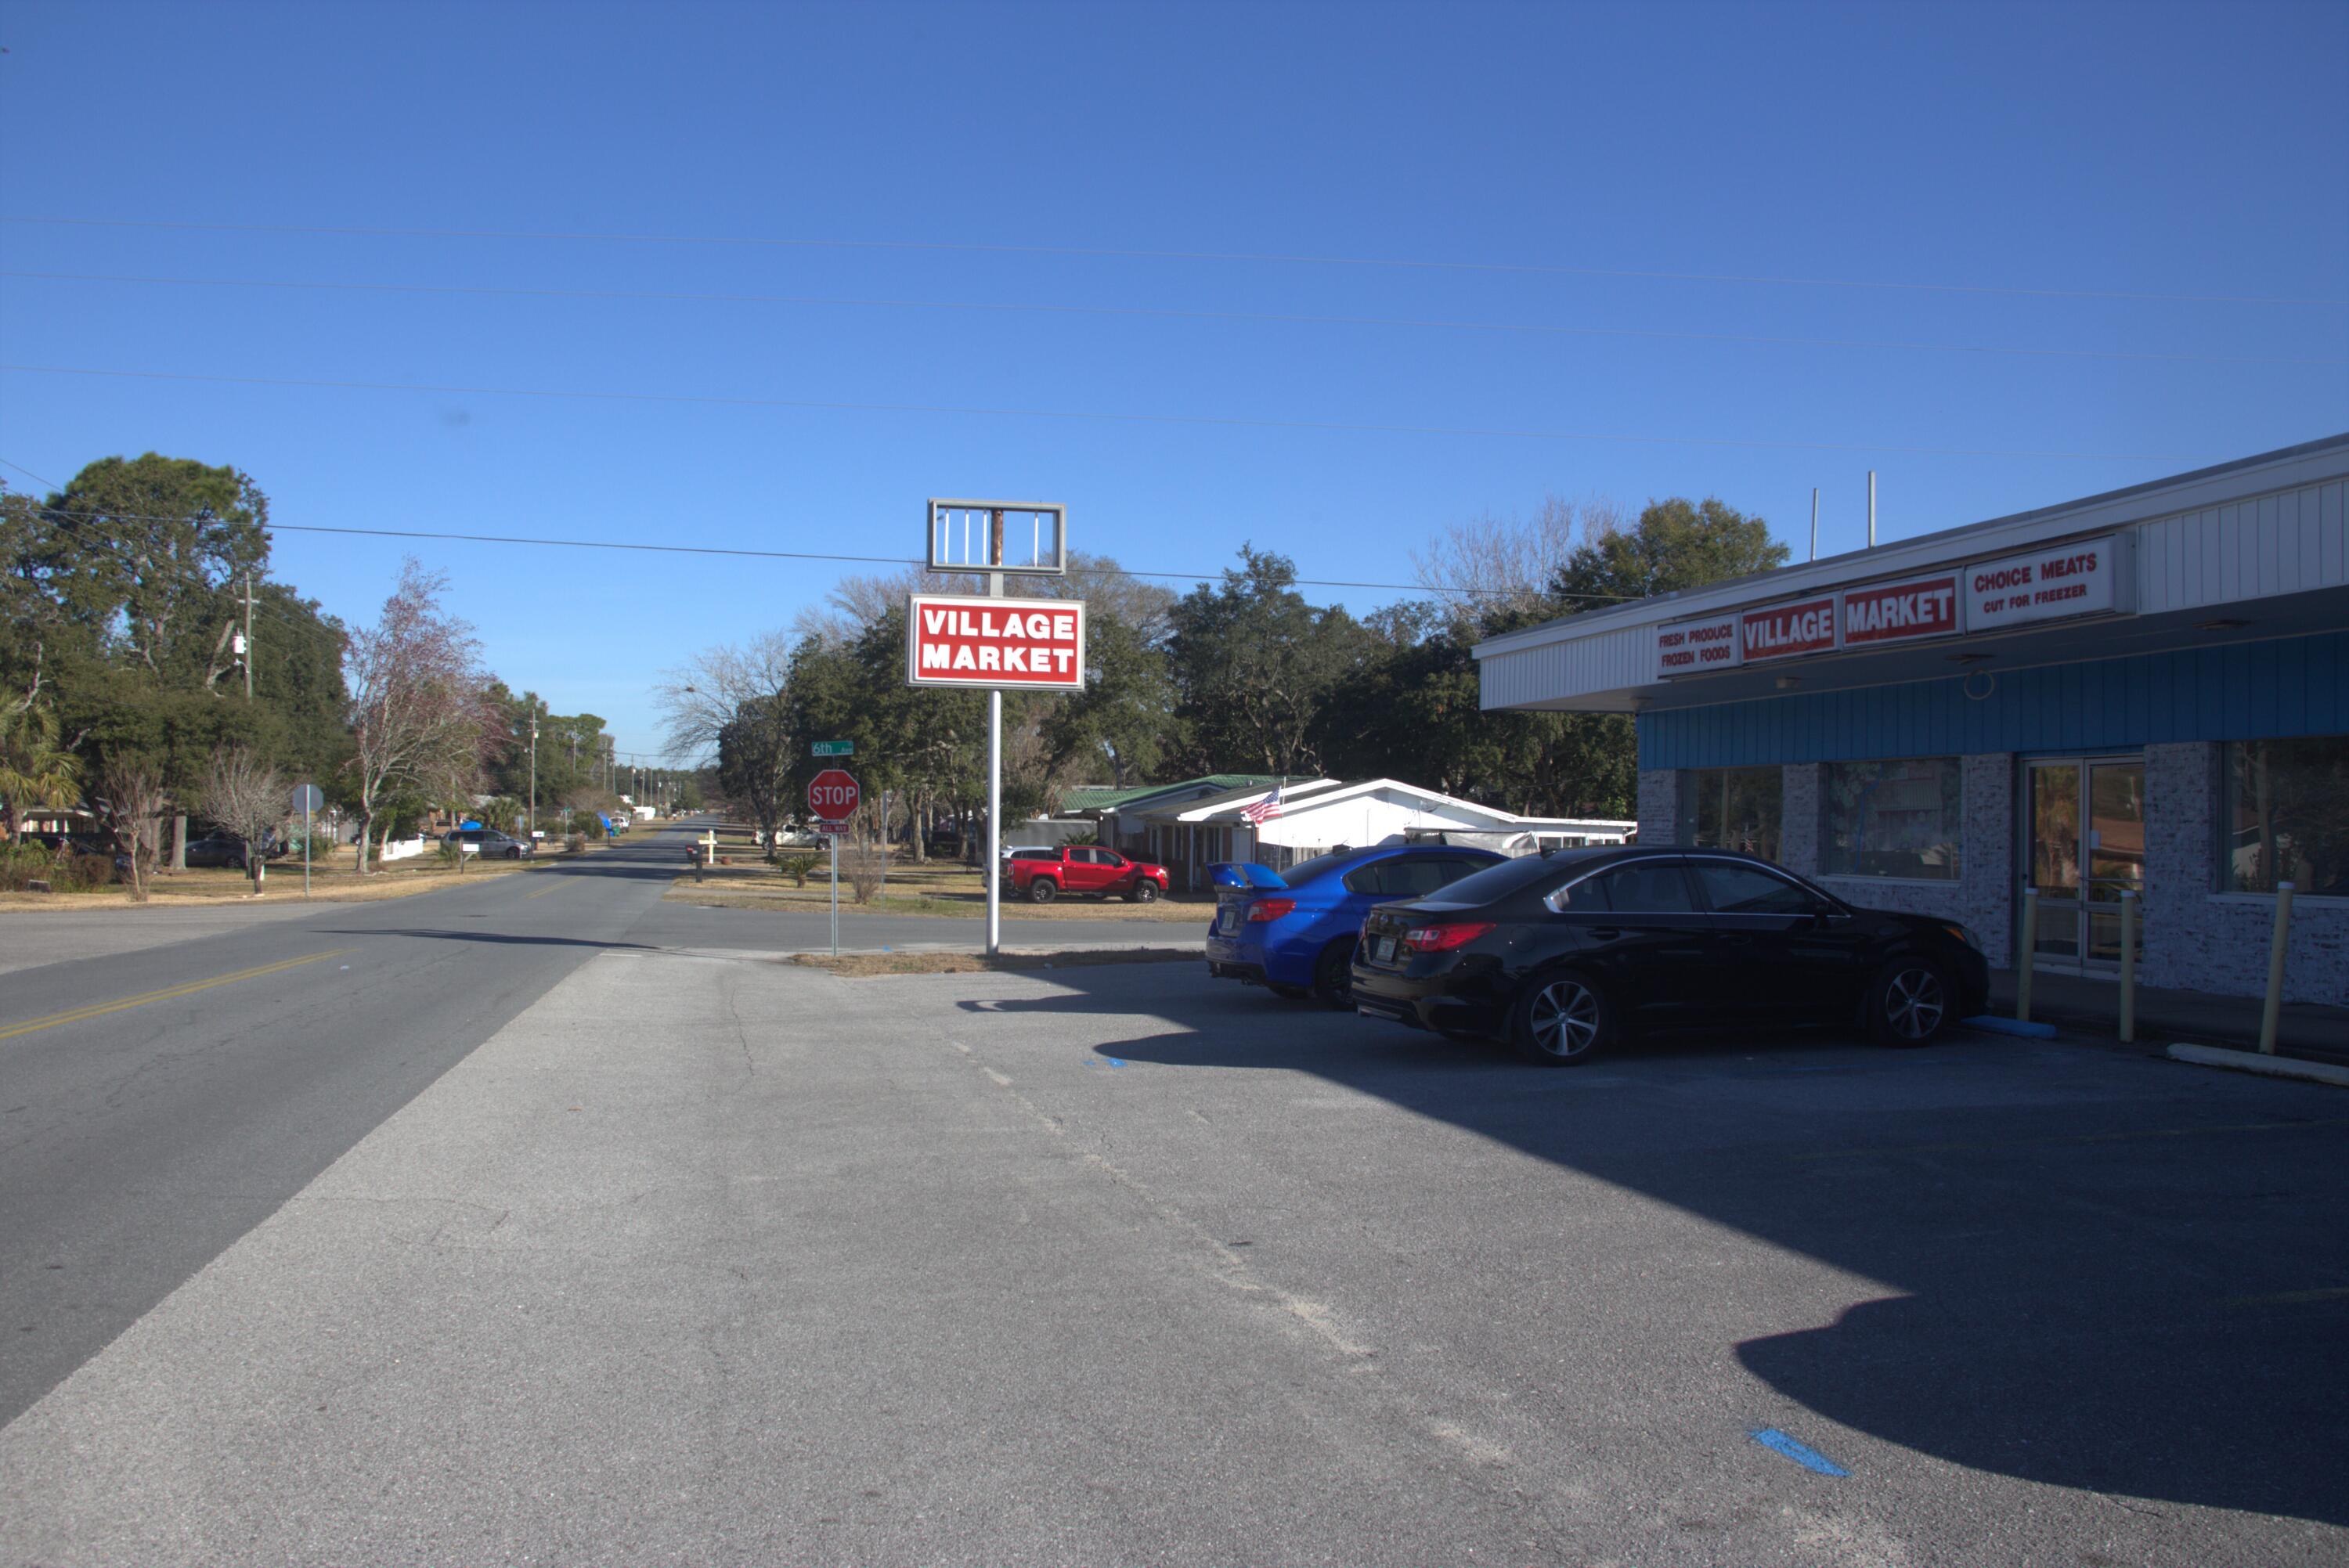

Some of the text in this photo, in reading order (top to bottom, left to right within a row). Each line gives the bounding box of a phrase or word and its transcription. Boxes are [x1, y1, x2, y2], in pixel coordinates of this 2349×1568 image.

[1975, 552, 2097, 593] CHOICE MEATS
[1983, 584, 2087, 613] CUT FOR FREEZER
[923, 610, 1074, 640] VILLAGE
[1745, 587, 1953, 651] VILLAGE MARKET
[1659, 624, 1733, 647] FRESH PRODUCE
[922, 643, 1074, 673] MARKET
[1662, 645, 1730, 667] FROZEN FOODS
[813, 743, 832, 754] 6th
[813, 786, 856, 805] STOP
